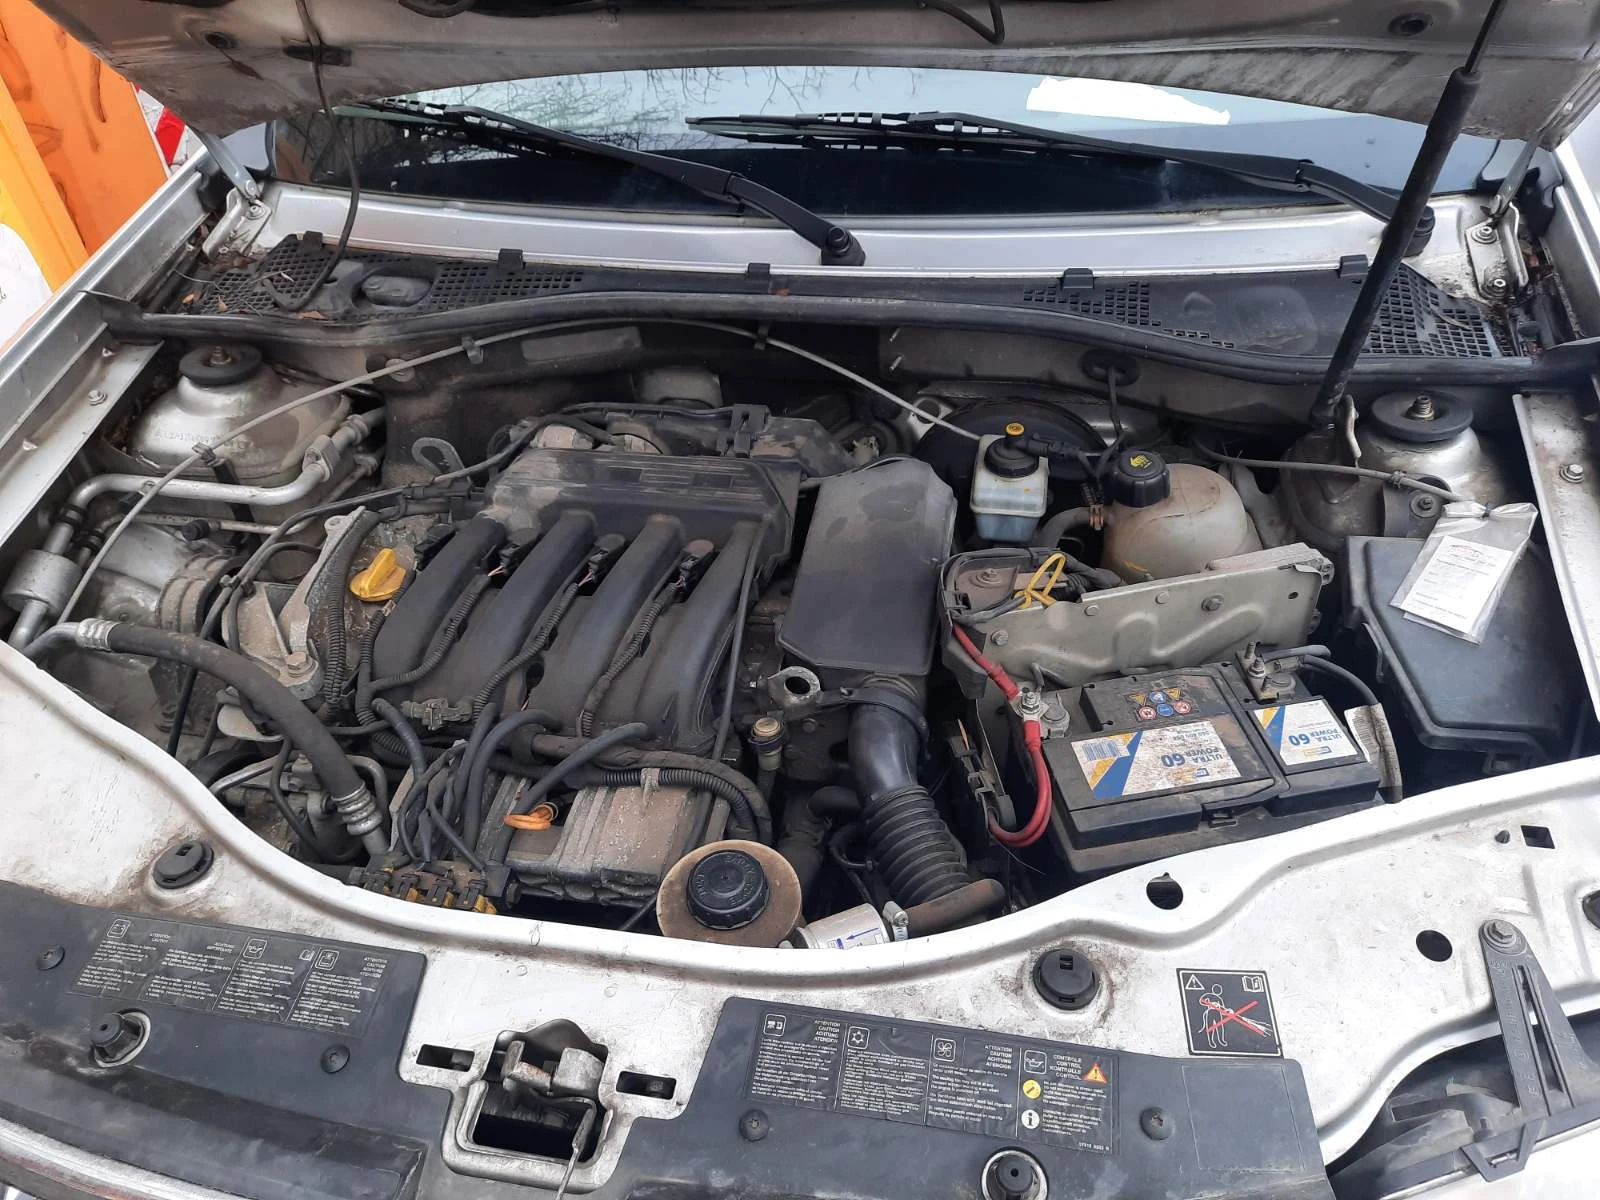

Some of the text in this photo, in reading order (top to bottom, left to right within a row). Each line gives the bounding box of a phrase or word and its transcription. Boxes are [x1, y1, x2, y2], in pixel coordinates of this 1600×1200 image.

[1288, 728, 1339, 746] POWER 60
[1315, 733, 1342, 742] ULTRA
[1161, 746, 1219, 768] POWER 60
[1191, 753, 1223, 764] ULTRA
[989, 1050, 1012, 1058] CAUTION
